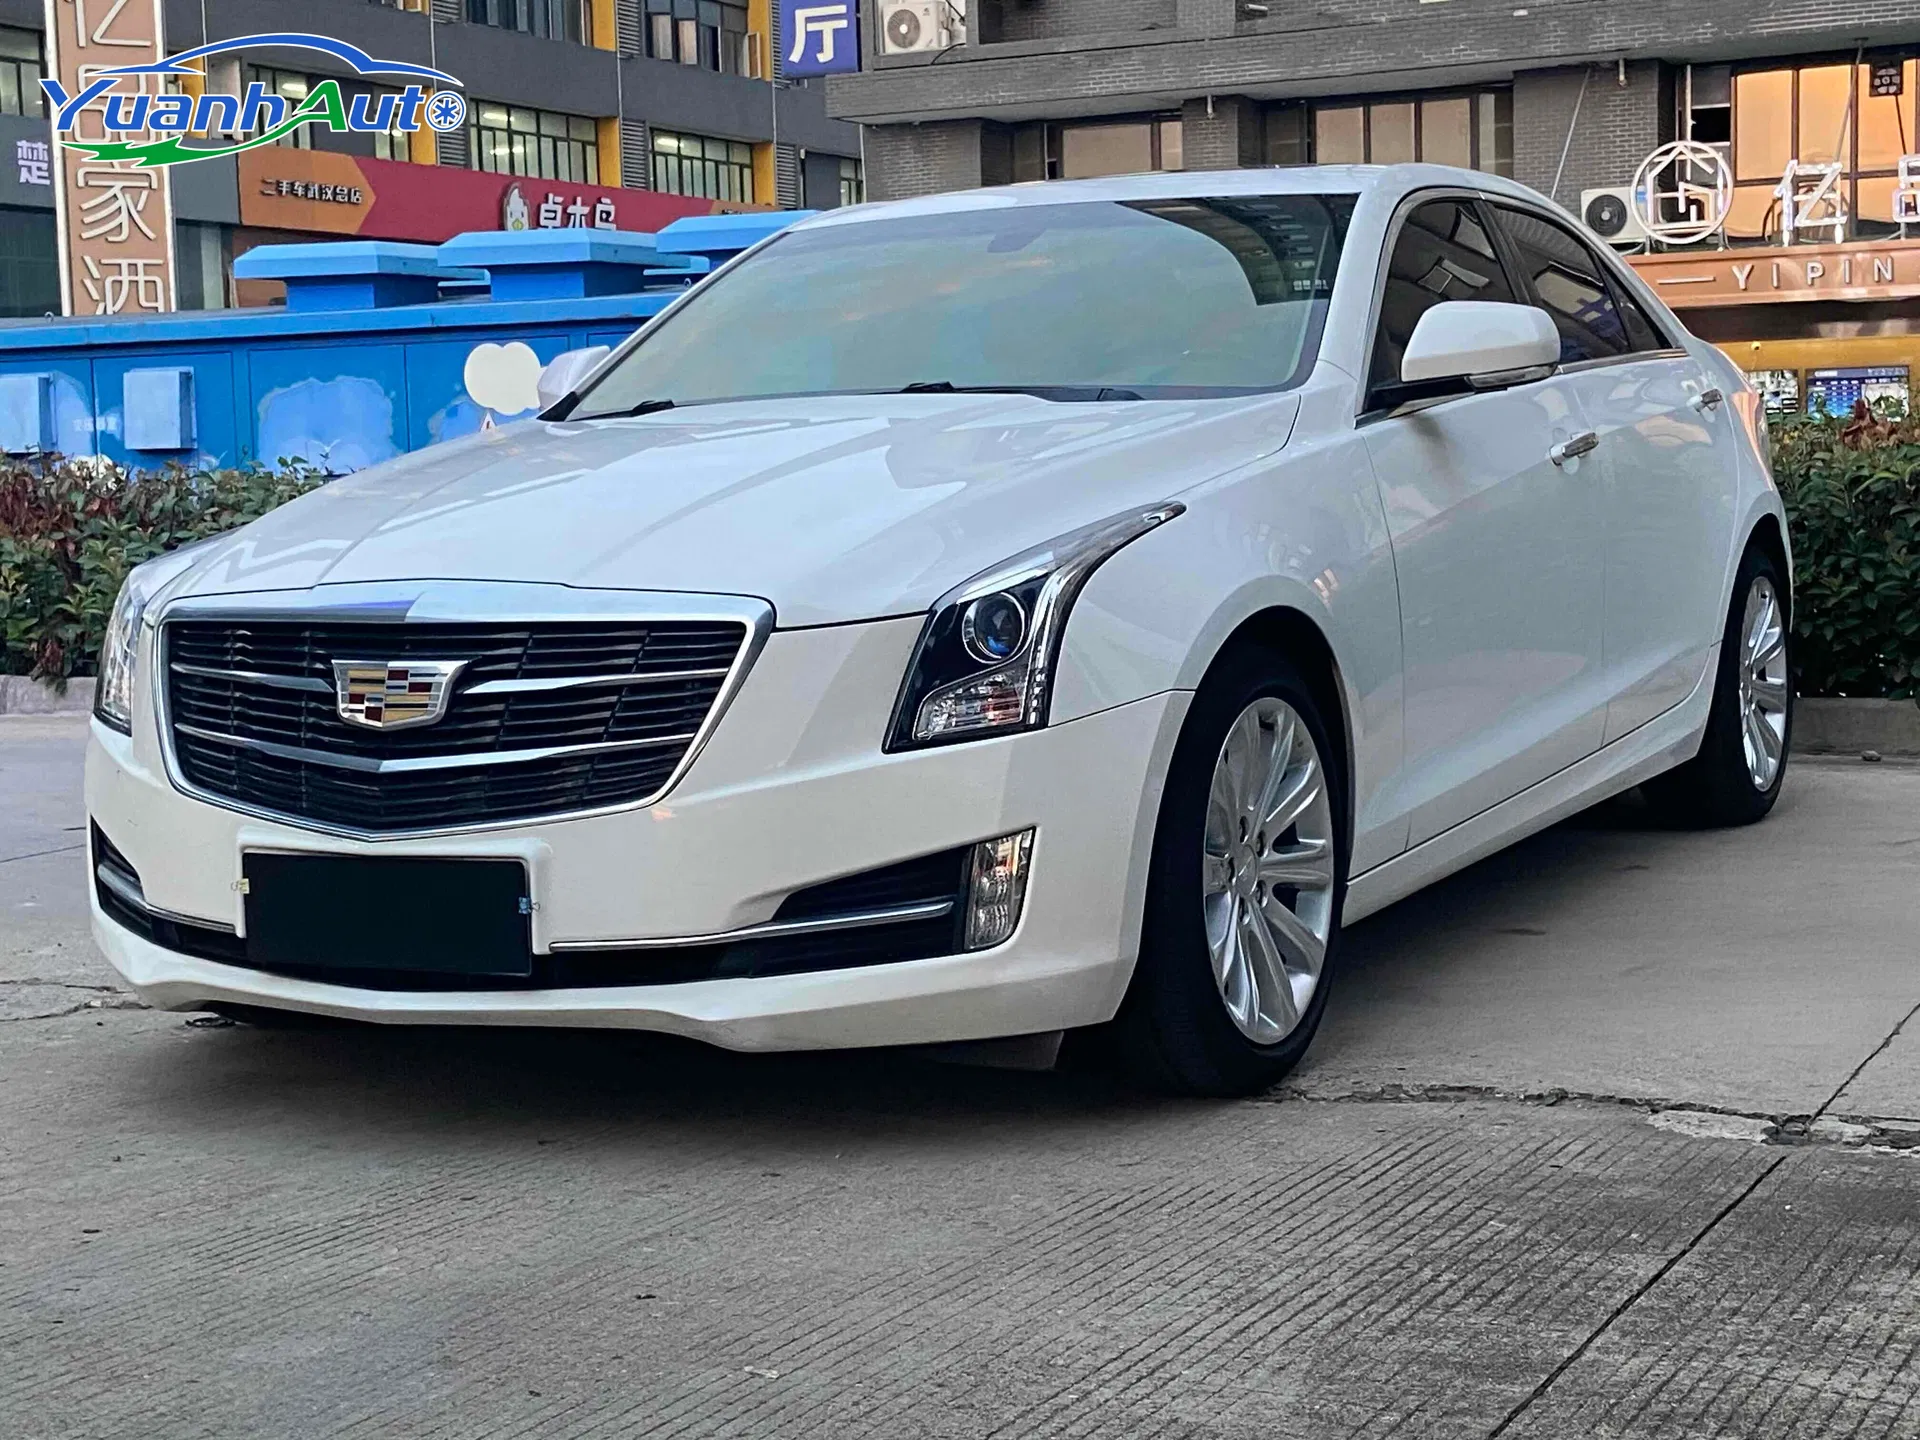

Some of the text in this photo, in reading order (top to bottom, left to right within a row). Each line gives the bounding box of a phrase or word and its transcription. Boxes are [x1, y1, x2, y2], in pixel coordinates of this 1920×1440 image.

[788, 5, 848, 63] 厅
[16, 139, 50, 185] 楚
[261, 178, 362, 204] 二手车武汉总店
